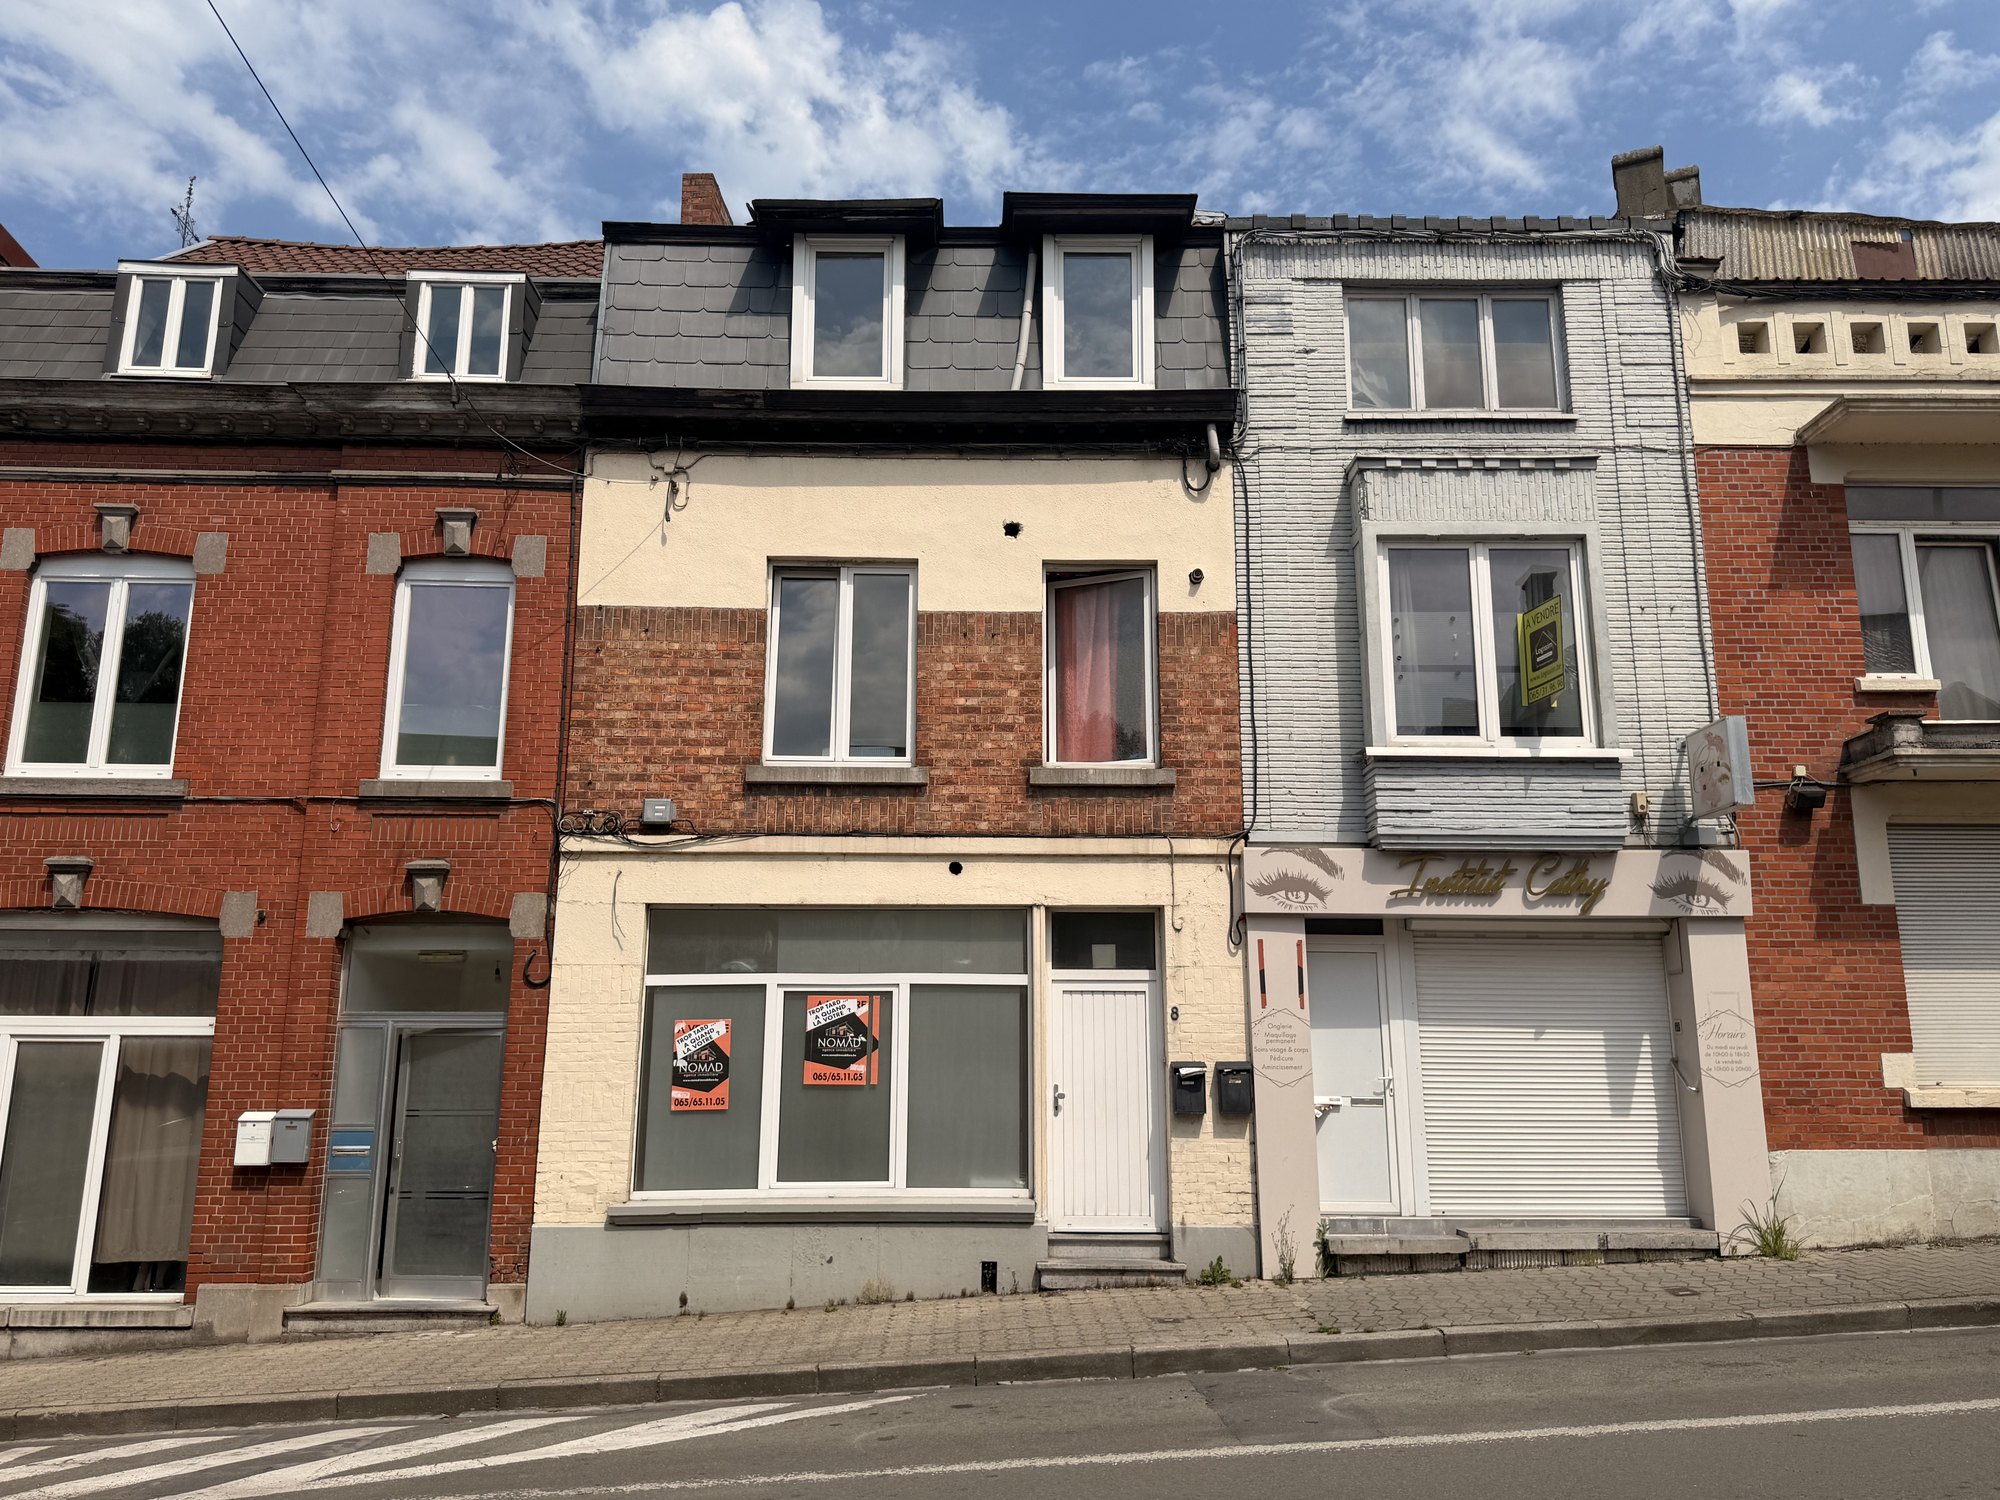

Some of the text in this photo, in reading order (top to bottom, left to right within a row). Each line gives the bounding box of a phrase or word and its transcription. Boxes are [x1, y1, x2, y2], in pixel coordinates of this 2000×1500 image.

[1526, 602, 1559, 630] A VENDRE
[1389, 853, 1612, 916] Institut Cathy
[808, 1005, 825, 1016] TROP
[825, 999, 842, 1010] TARD
[821, 1004, 847, 1018] QUAND
[1170, 1006, 1180, 1022] 8
[822, 1011, 845, 1023] VOTRE
[1267, 1022, 1292, 1030] Onglerie
[1705, 1022, 1747, 1041] Horaire
[676, 1032, 693, 1045] TROP
[693, 1024, 709, 1036] TARD
[690, 1028, 715, 1045] QUAND
[692, 1035, 714, 1049] VOTRE
[817, 1037, 862, 1048] NOMAD
[679, 1062, 724, 1073] NOMAD
[812, 1072, 863, 1082] 065/65.11.05
[674, 1097, 725, 1107] 065/65.11.05
